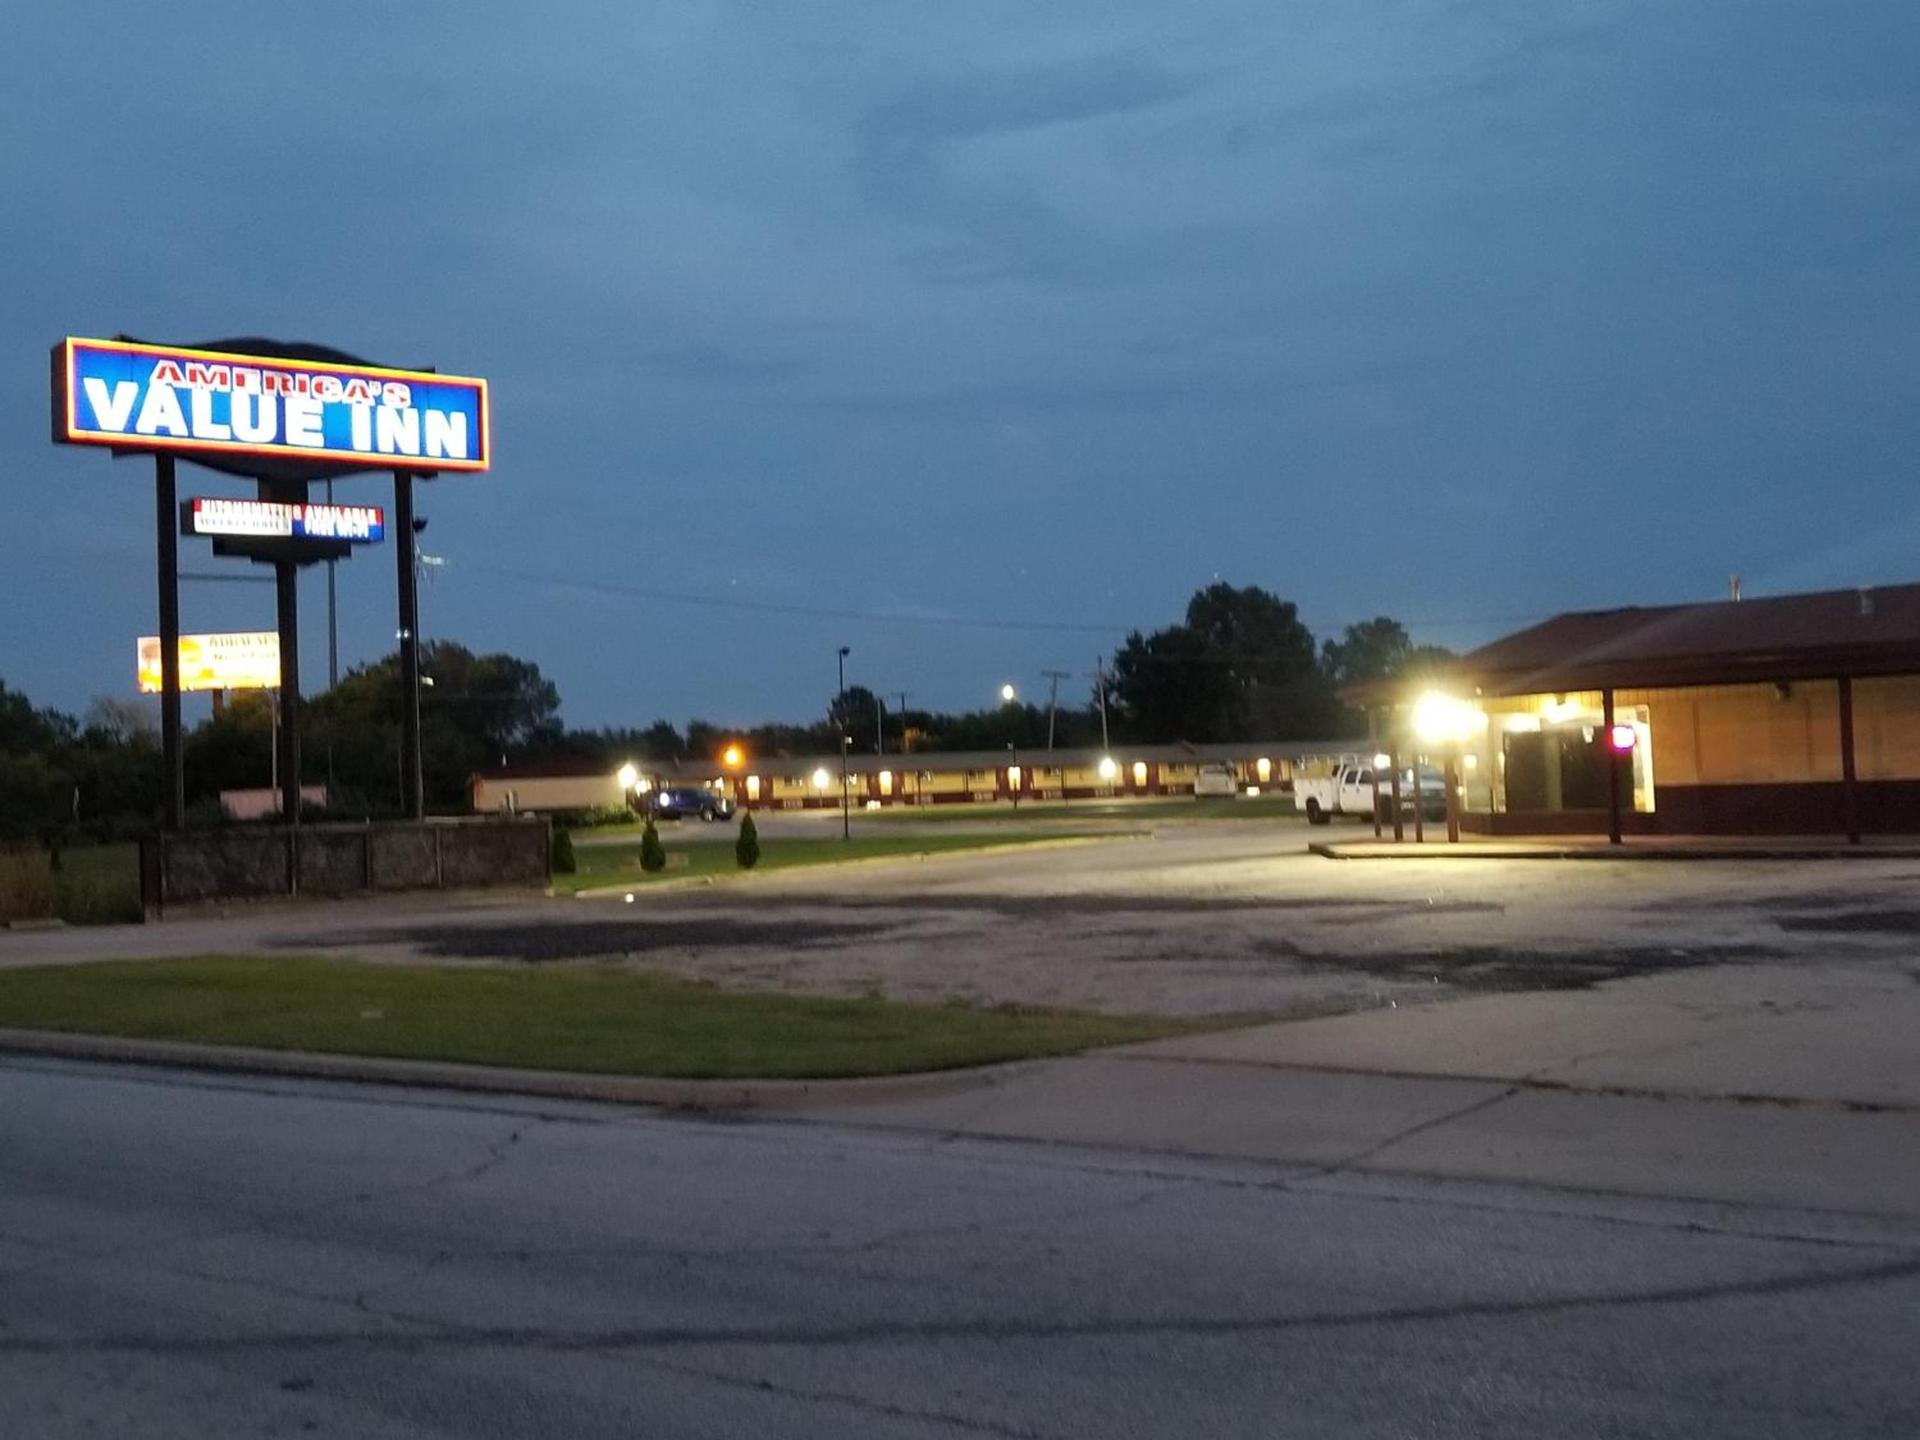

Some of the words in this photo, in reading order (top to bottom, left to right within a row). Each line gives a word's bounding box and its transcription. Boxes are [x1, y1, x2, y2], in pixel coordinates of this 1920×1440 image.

[151, 360, 412, 408] AMERICA'S
[83, 377, 325, 444] VALUE
[350, 402, 467, 458] INN
